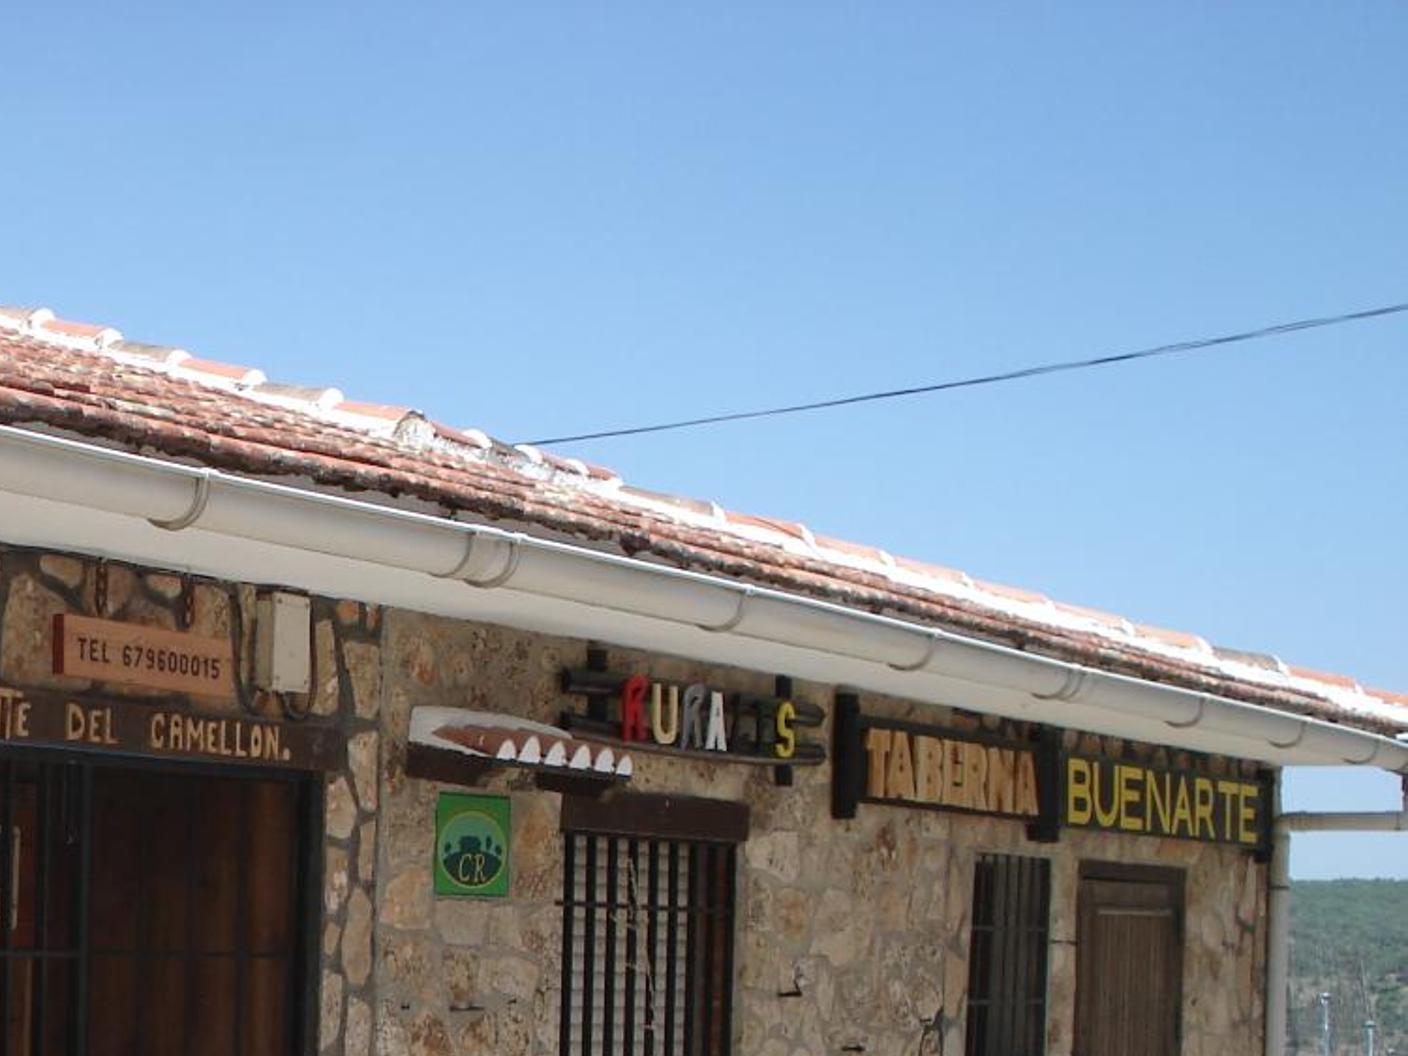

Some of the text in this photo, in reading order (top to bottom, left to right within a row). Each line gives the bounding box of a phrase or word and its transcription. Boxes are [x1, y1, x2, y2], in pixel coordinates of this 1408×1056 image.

[77, 637, 221, 680] TEL 679600015
[65, 702, 119, 745] DEL
[150, 712, 291, 761] CAMELLON.
[867, 727, 1040, 816] TABERNA
[1066, 757, 1261, 844] BUENARTE
[458, 853, 487, 883] CR
